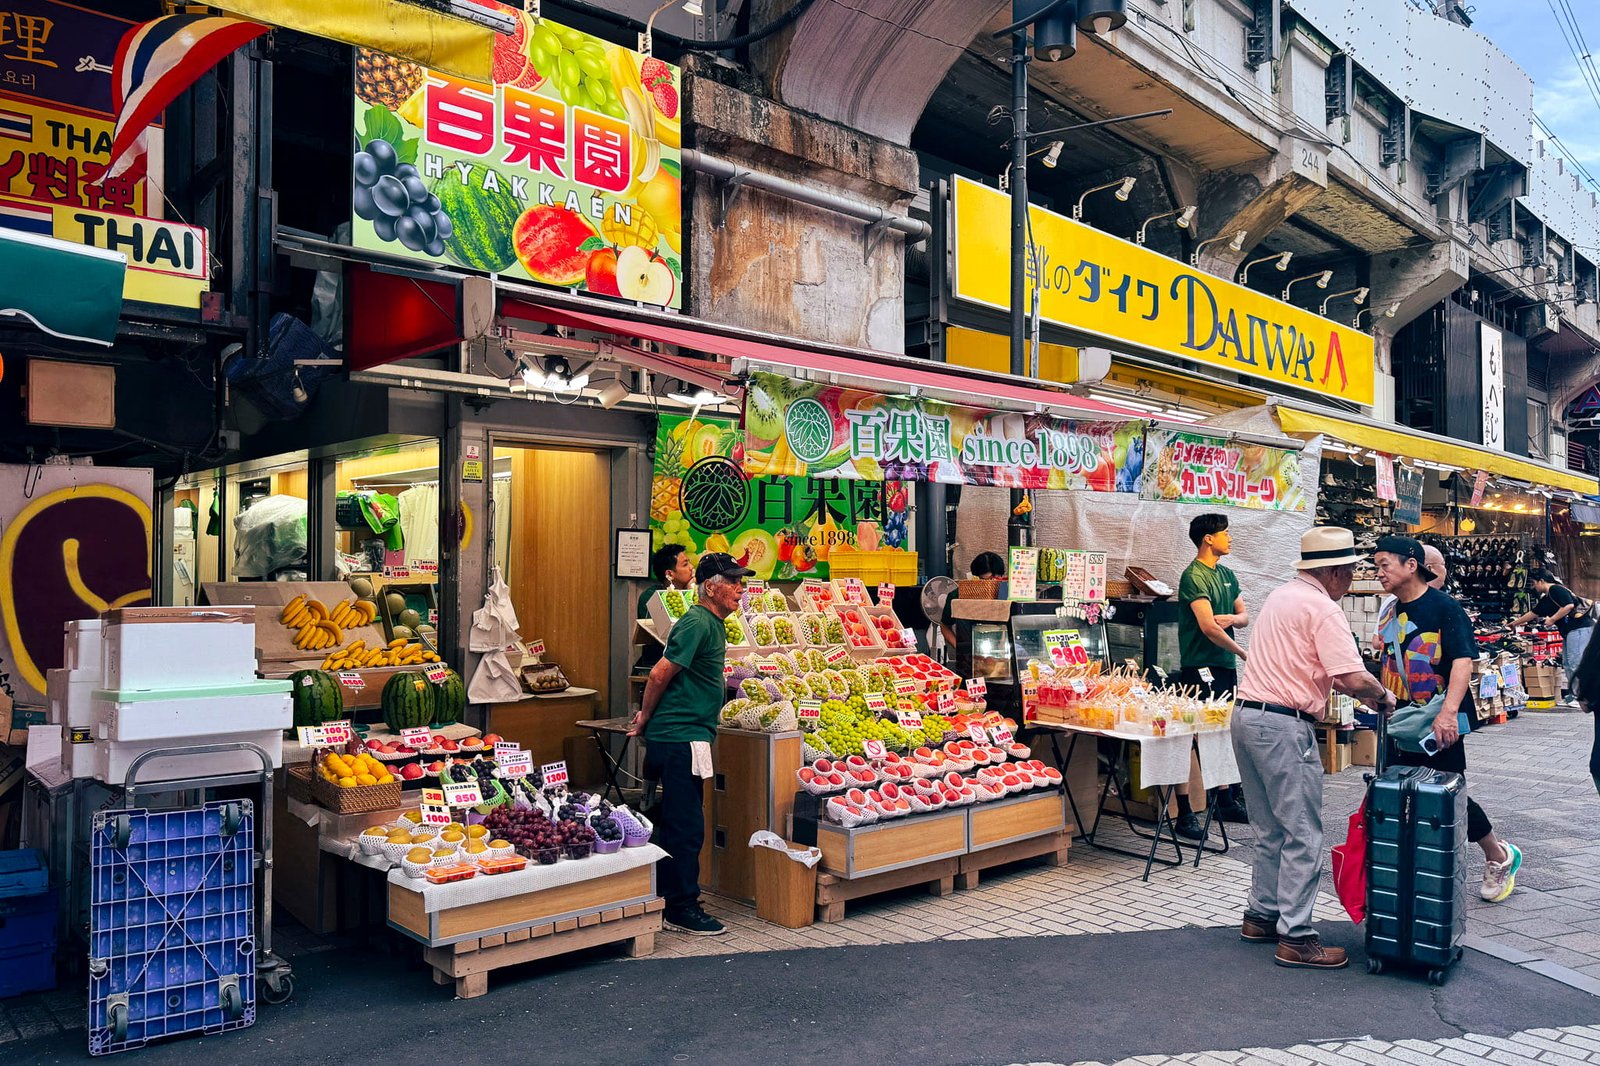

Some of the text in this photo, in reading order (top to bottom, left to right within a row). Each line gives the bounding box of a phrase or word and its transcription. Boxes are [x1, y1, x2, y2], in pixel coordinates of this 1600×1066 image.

[46, 119, 113, 157] THA
[424, 72, 632, 193] 百果園
[1301, 148, 1320, 172] 244
[425, 154, 632, 226] HYAKKAEN
[74, 213, 194, 270] THAI
[1025, 241, 1315, 382] 靴のダイワ DAIWA
[845, 409, 953, 463] 百果園
[1180, 468, 1276, 502] カットフルーツ
[757, 475, 890, 526] 百果園
[1089, 554, 1104, 564] SNS
[529, 645, 544, 655] 150
[969, 686, 986, 694] 1700
[939, 699, 954, 710] 1200
[799, 708, 820, 717] 2500
[324, 727, 342, 735] 100
[326, 735, 345, 744] 850
[409, 736, 428, 744] 800
[508, 765, 527, 774] 600
[545, 772, 567, 783] 1300
[455, 793, 477, 803] 850
[426, 814, 450, 823] 1000
